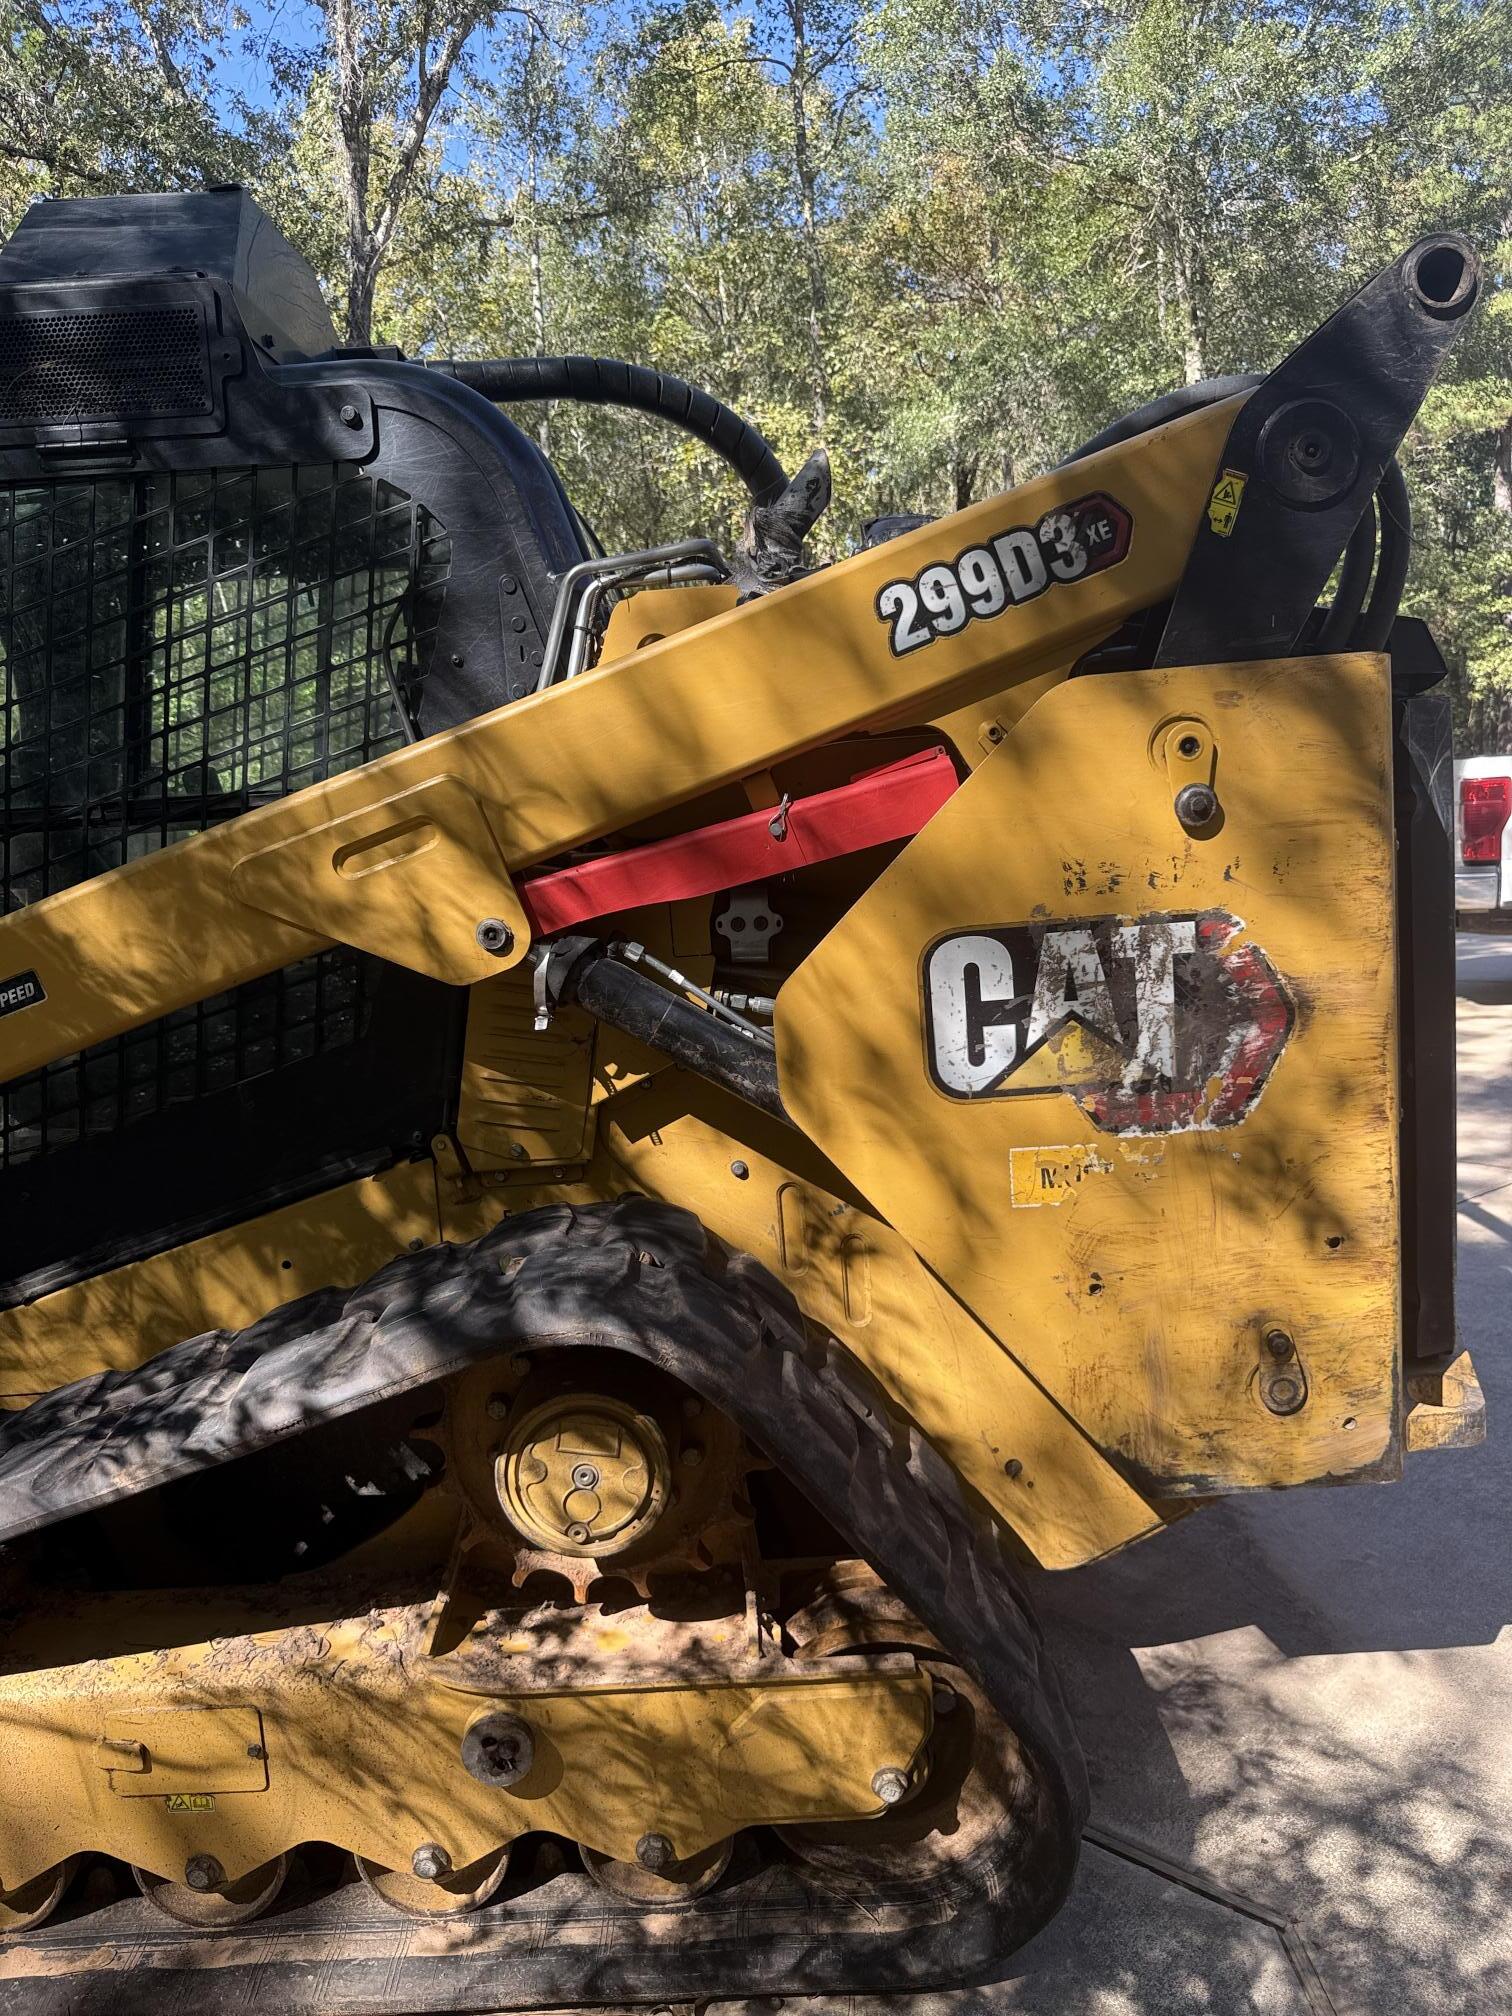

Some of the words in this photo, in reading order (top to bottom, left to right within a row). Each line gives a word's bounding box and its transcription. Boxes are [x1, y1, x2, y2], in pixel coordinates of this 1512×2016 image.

[879, 511, 1088, 652] 299D3
[1086, 519, 1112, 546] XE
[929, 921, 1196, 1092] CAT
